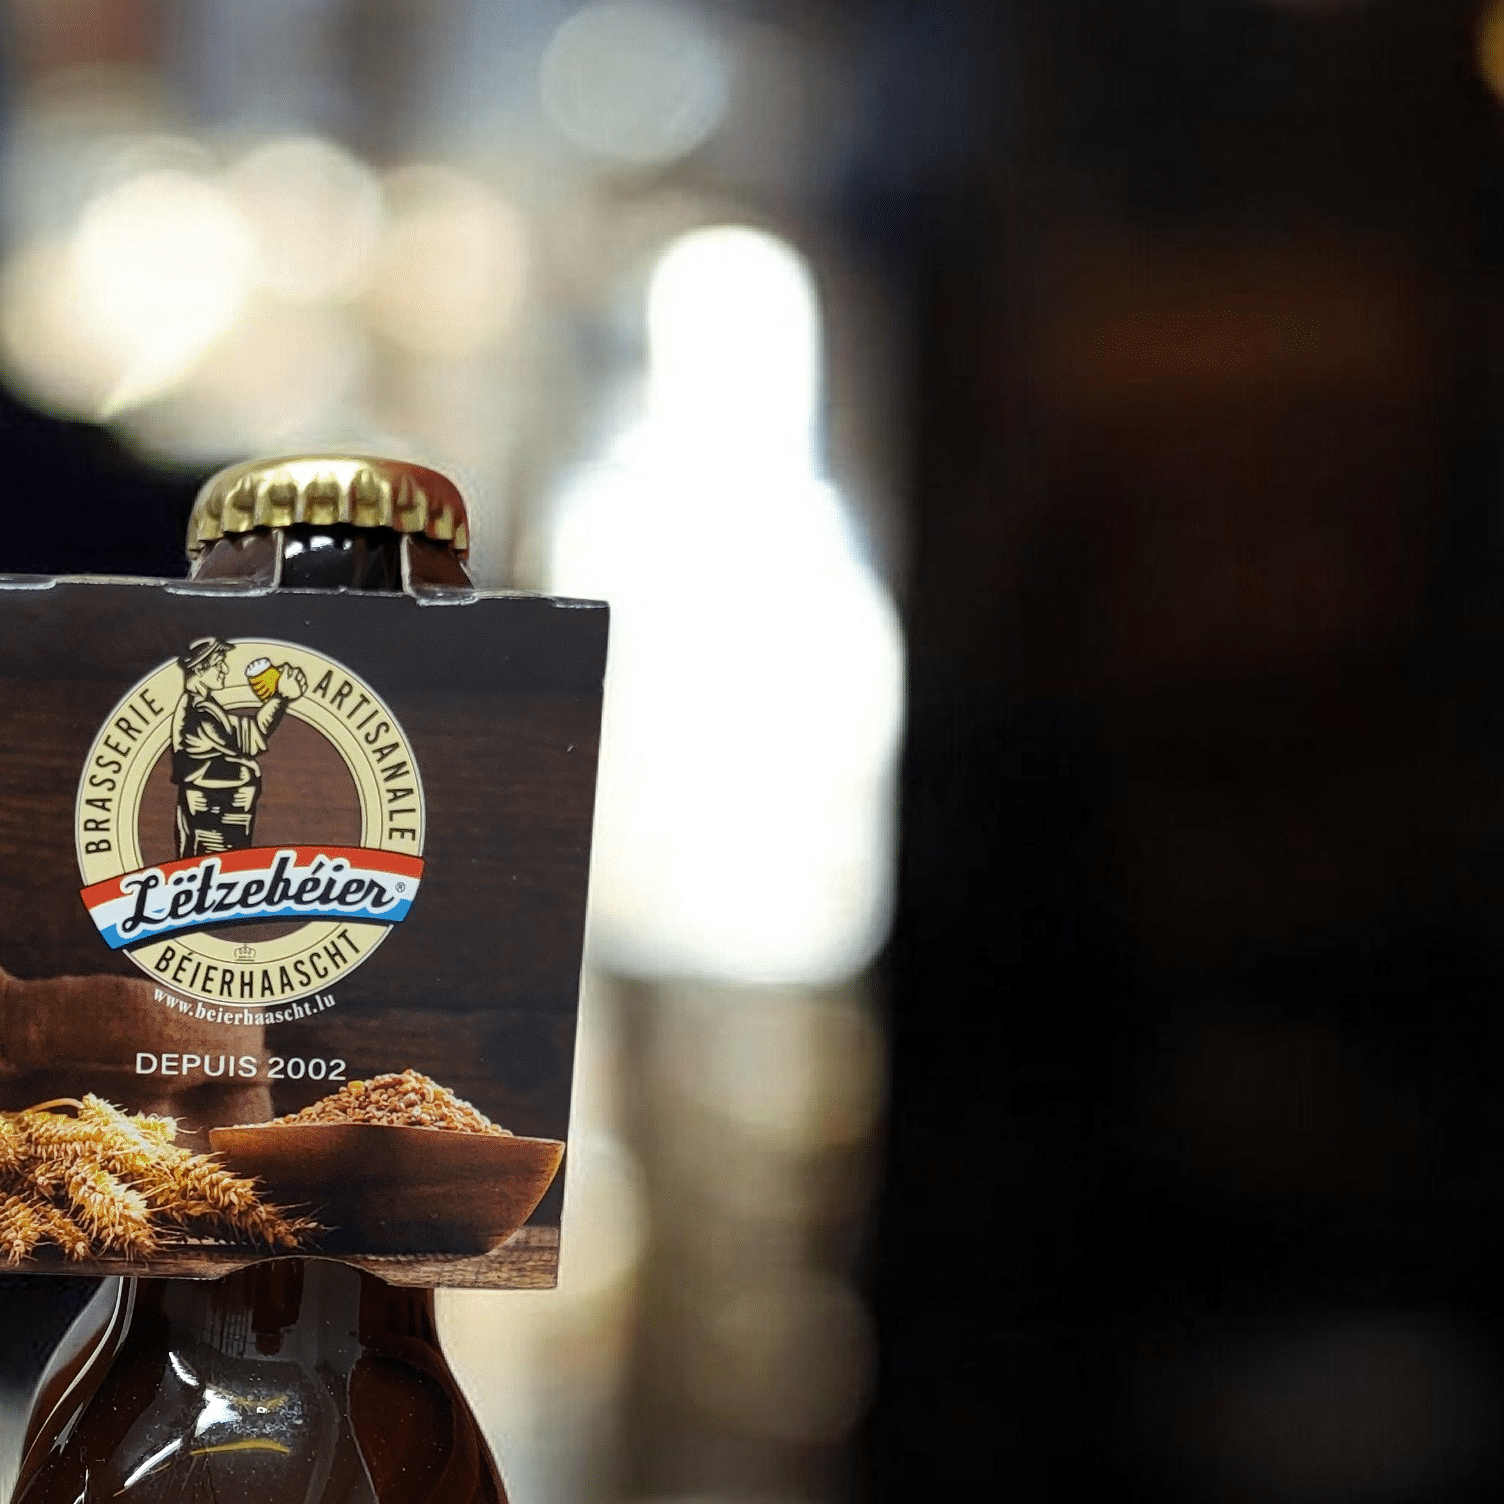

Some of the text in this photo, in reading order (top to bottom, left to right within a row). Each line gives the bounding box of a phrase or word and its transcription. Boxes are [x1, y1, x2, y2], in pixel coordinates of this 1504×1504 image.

[83, 688, 165, 855] BRASSERIE
[312, 669, 416, 842] ARTISANALE
[153, 929, 361, 999] BÉIERHAASCHT
[153, 986, 336, 1027] www.beierhaascht.lu
[135, 1052, 347, 1081] DEPUIS 2002
